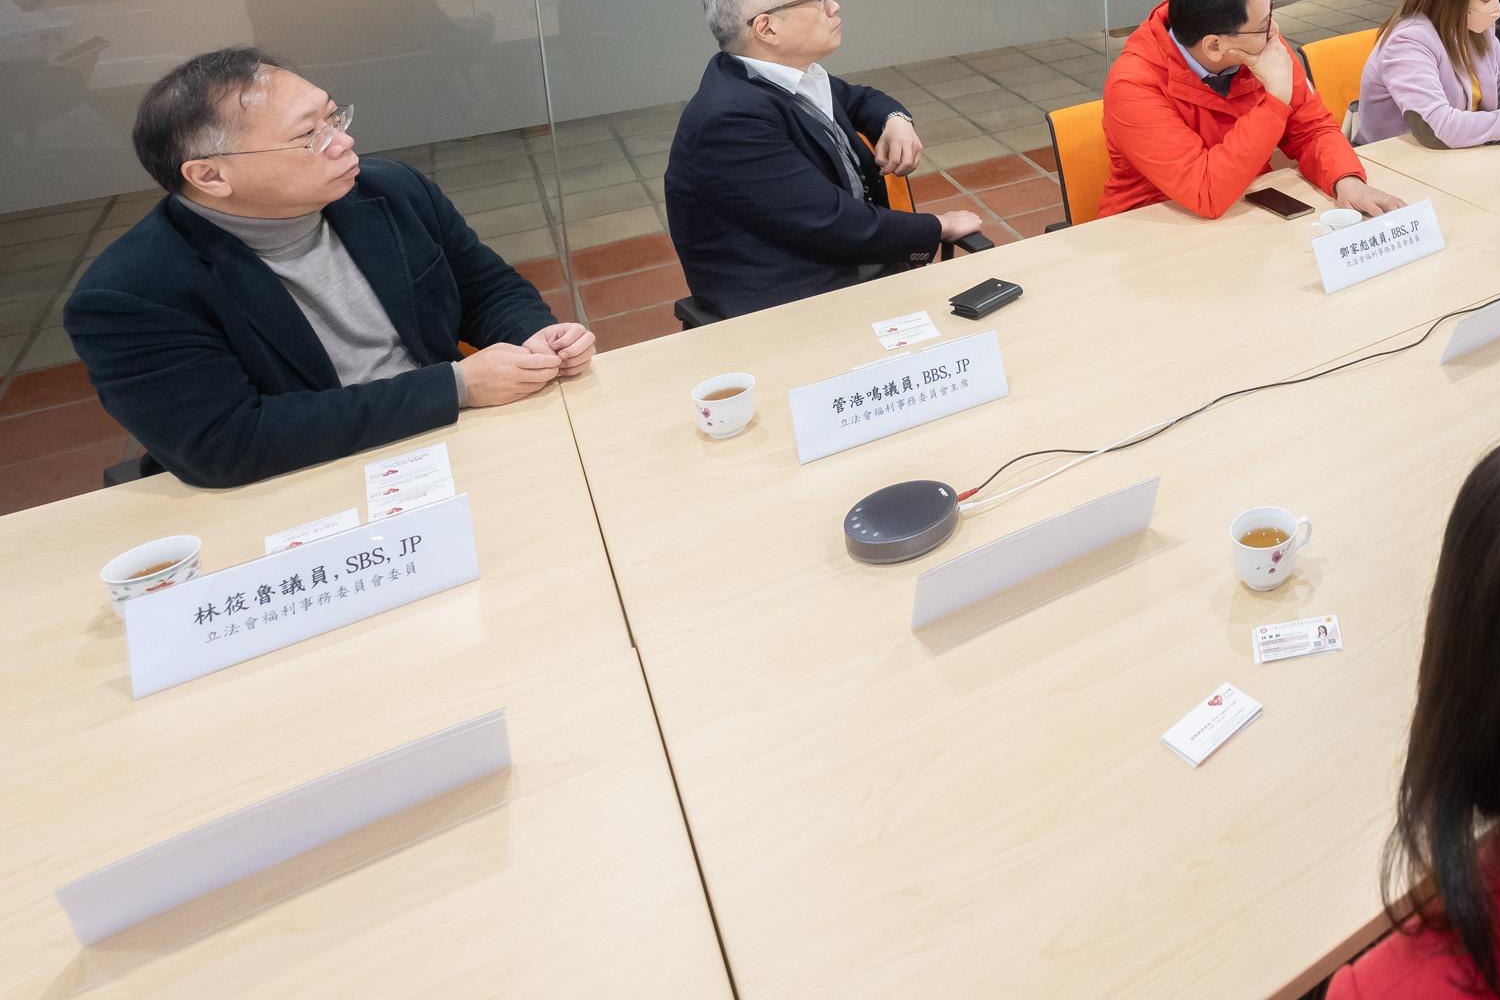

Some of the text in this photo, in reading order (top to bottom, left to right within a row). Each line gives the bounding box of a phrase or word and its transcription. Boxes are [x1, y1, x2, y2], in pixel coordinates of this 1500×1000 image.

[1410, 219, 1420, 233] JP
[922, 365, 952, 385] BBS,
[956, 358, 971, 375] JP
[840, 379, 970, 429] 立法會福利事務委員會主席
[346, 547, 391, 575] SBS,
[399, 535, 422, 557] JP
[205, 561, 417, 644] 立法會福利事務委員會委員
